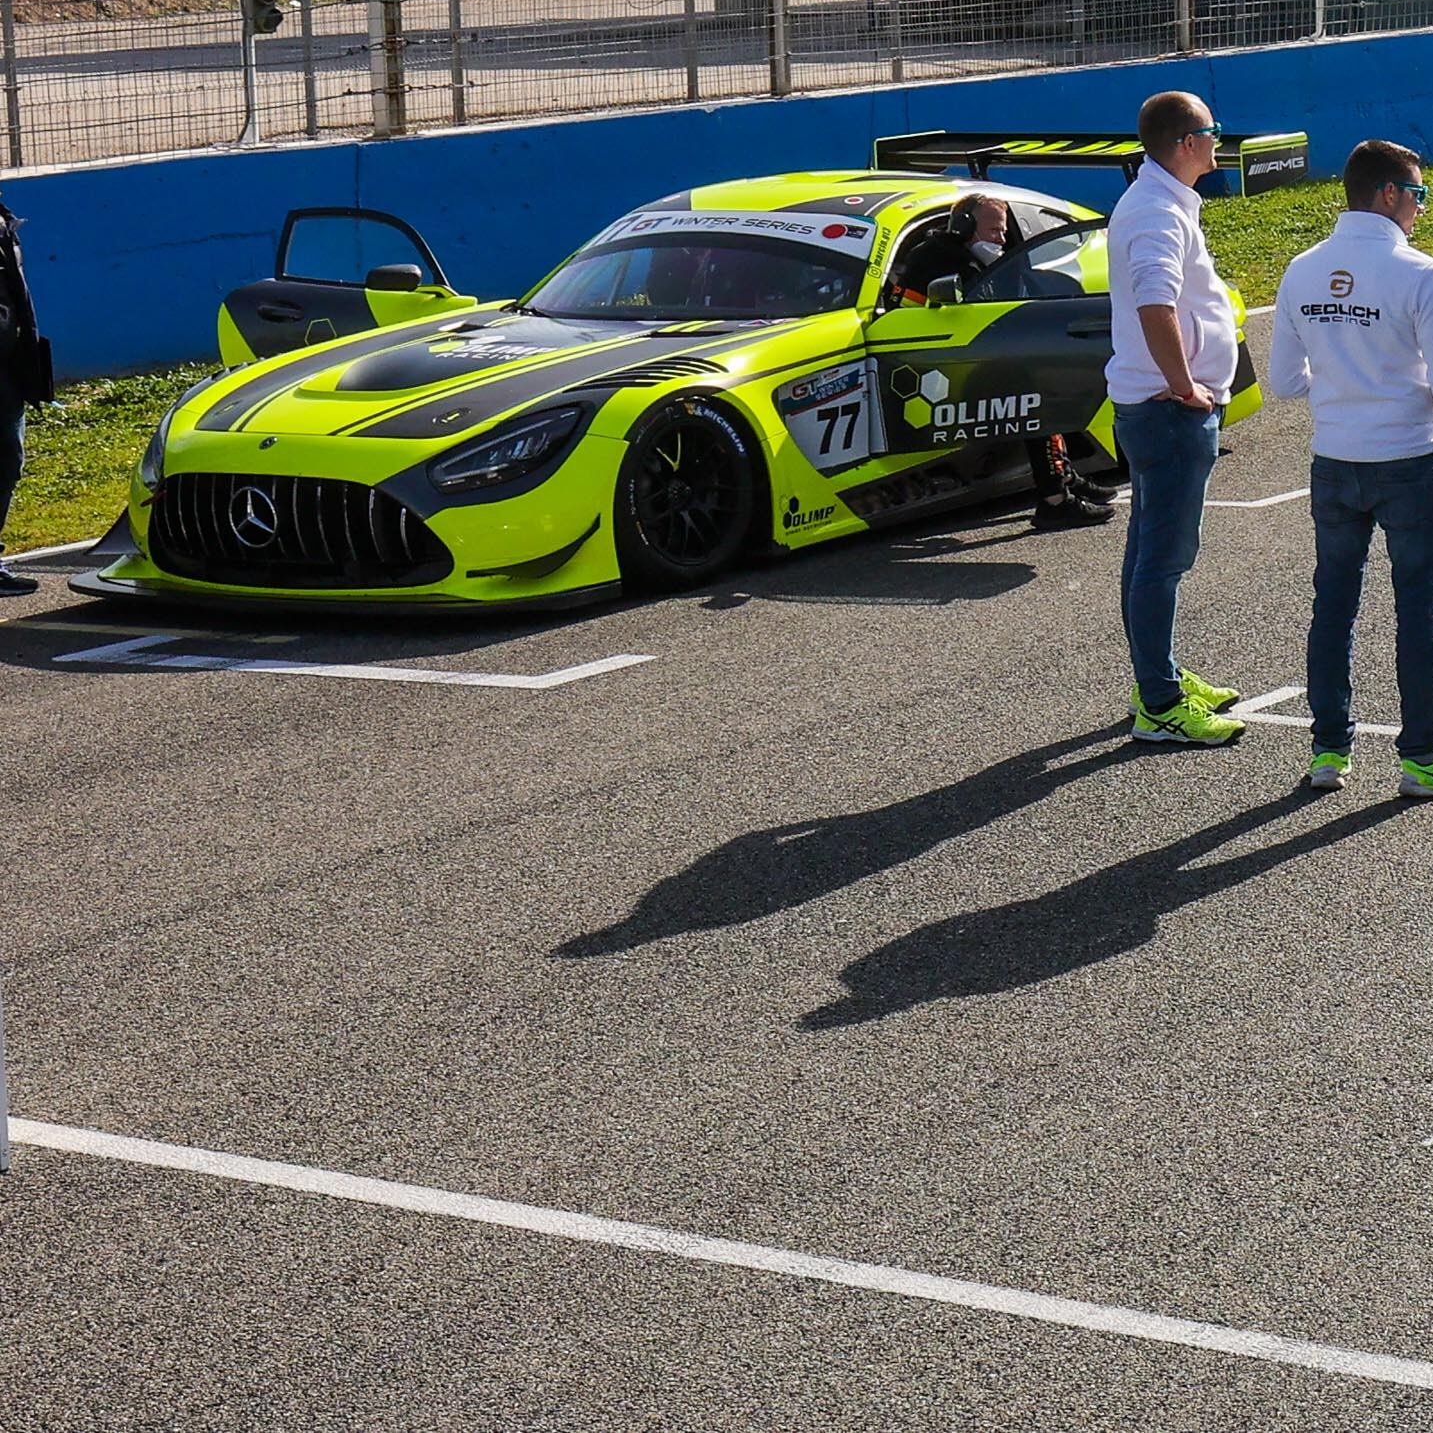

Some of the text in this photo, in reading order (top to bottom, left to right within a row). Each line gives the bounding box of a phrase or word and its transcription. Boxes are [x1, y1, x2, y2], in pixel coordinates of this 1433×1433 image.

[1265, 157, 1305, 172] AMG
[631, 216, 817, 235] GT WINTER SERIES
[1300, 303, 1380, 321] GEDLICH
[1308, 315, 1371, 327] racing
[790, 377, 819, 400] GT
[934, 392, 1042, 428] OLIMP
[703, 407, 747, 454] MICHELIN
[816, 401, 861, 455] 77
[933, 418, 1041, 443] RACING
[792, 505, 836, 528] OLIMP
